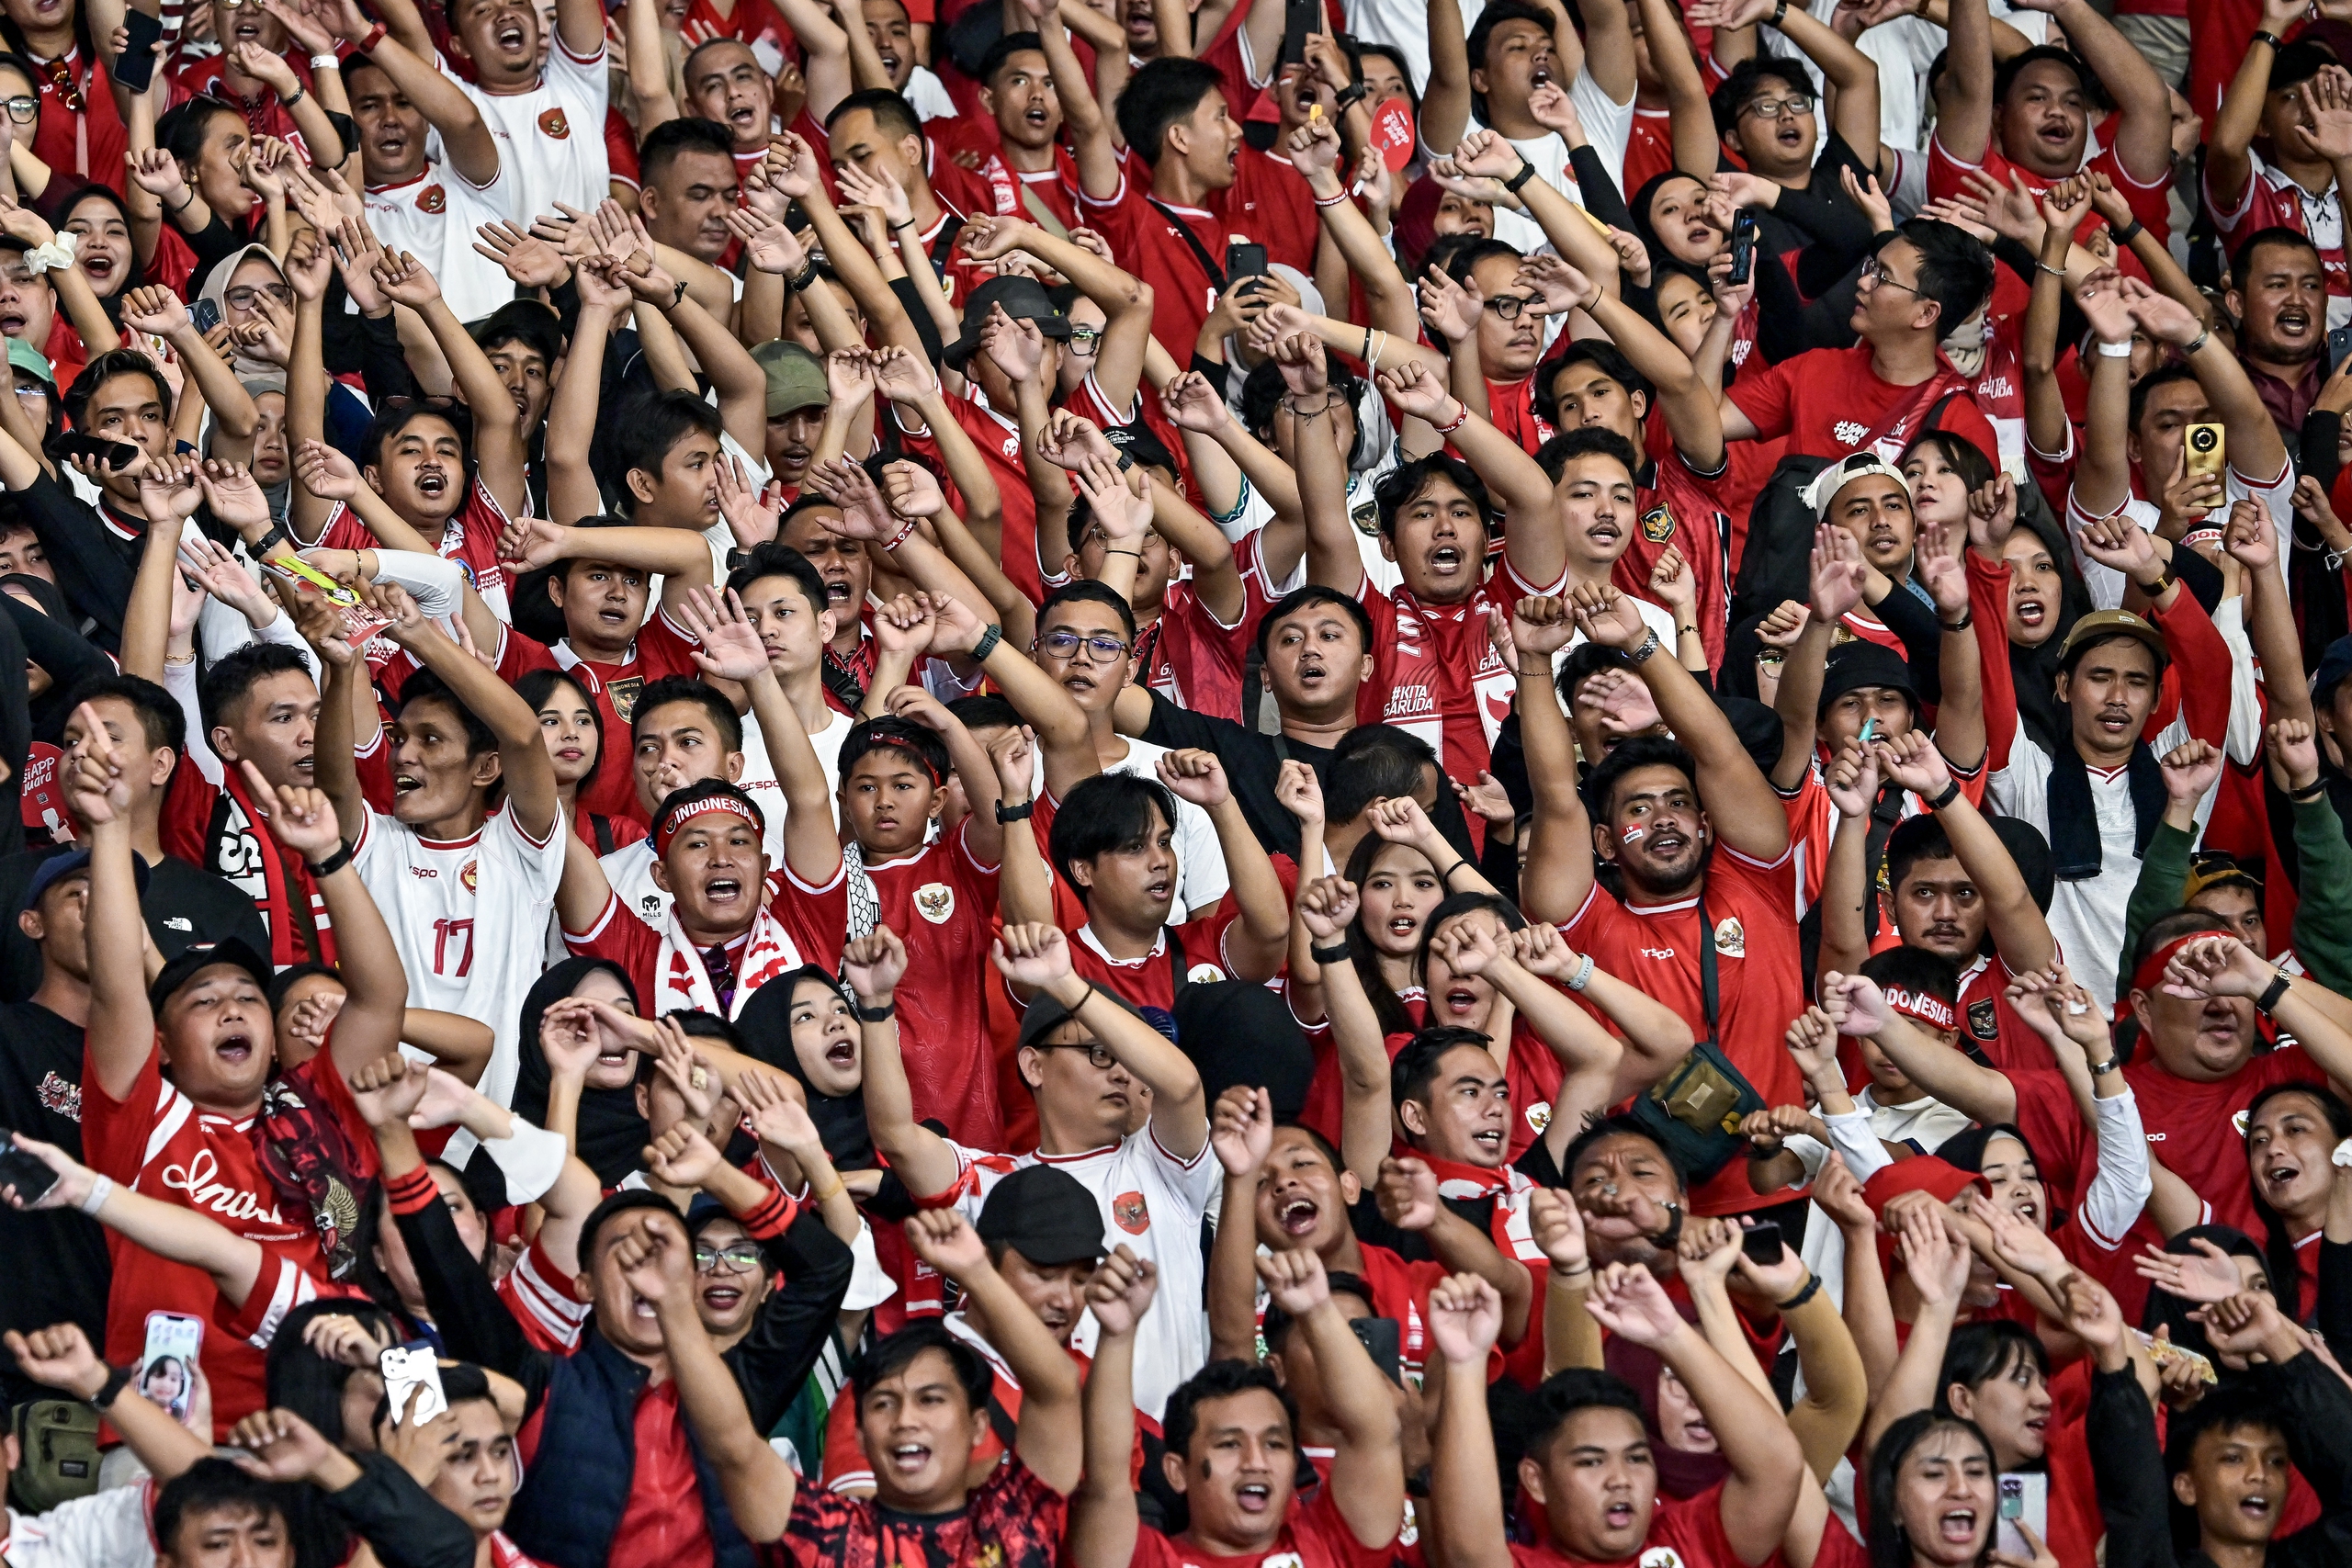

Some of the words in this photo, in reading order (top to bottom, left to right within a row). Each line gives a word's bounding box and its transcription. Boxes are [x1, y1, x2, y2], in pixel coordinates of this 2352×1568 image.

[612, 682, 640, 692] INDONESIA
[1391, 684, 1428, 704] #KITA
[1383, 697, 1433, 717] GARUDA
[22, 772, 52, 796] juara
[675, 796, 754, 824] INDONESIA
[409, 865, 438, 879] spo
[433, 918, 474, 977] 17
